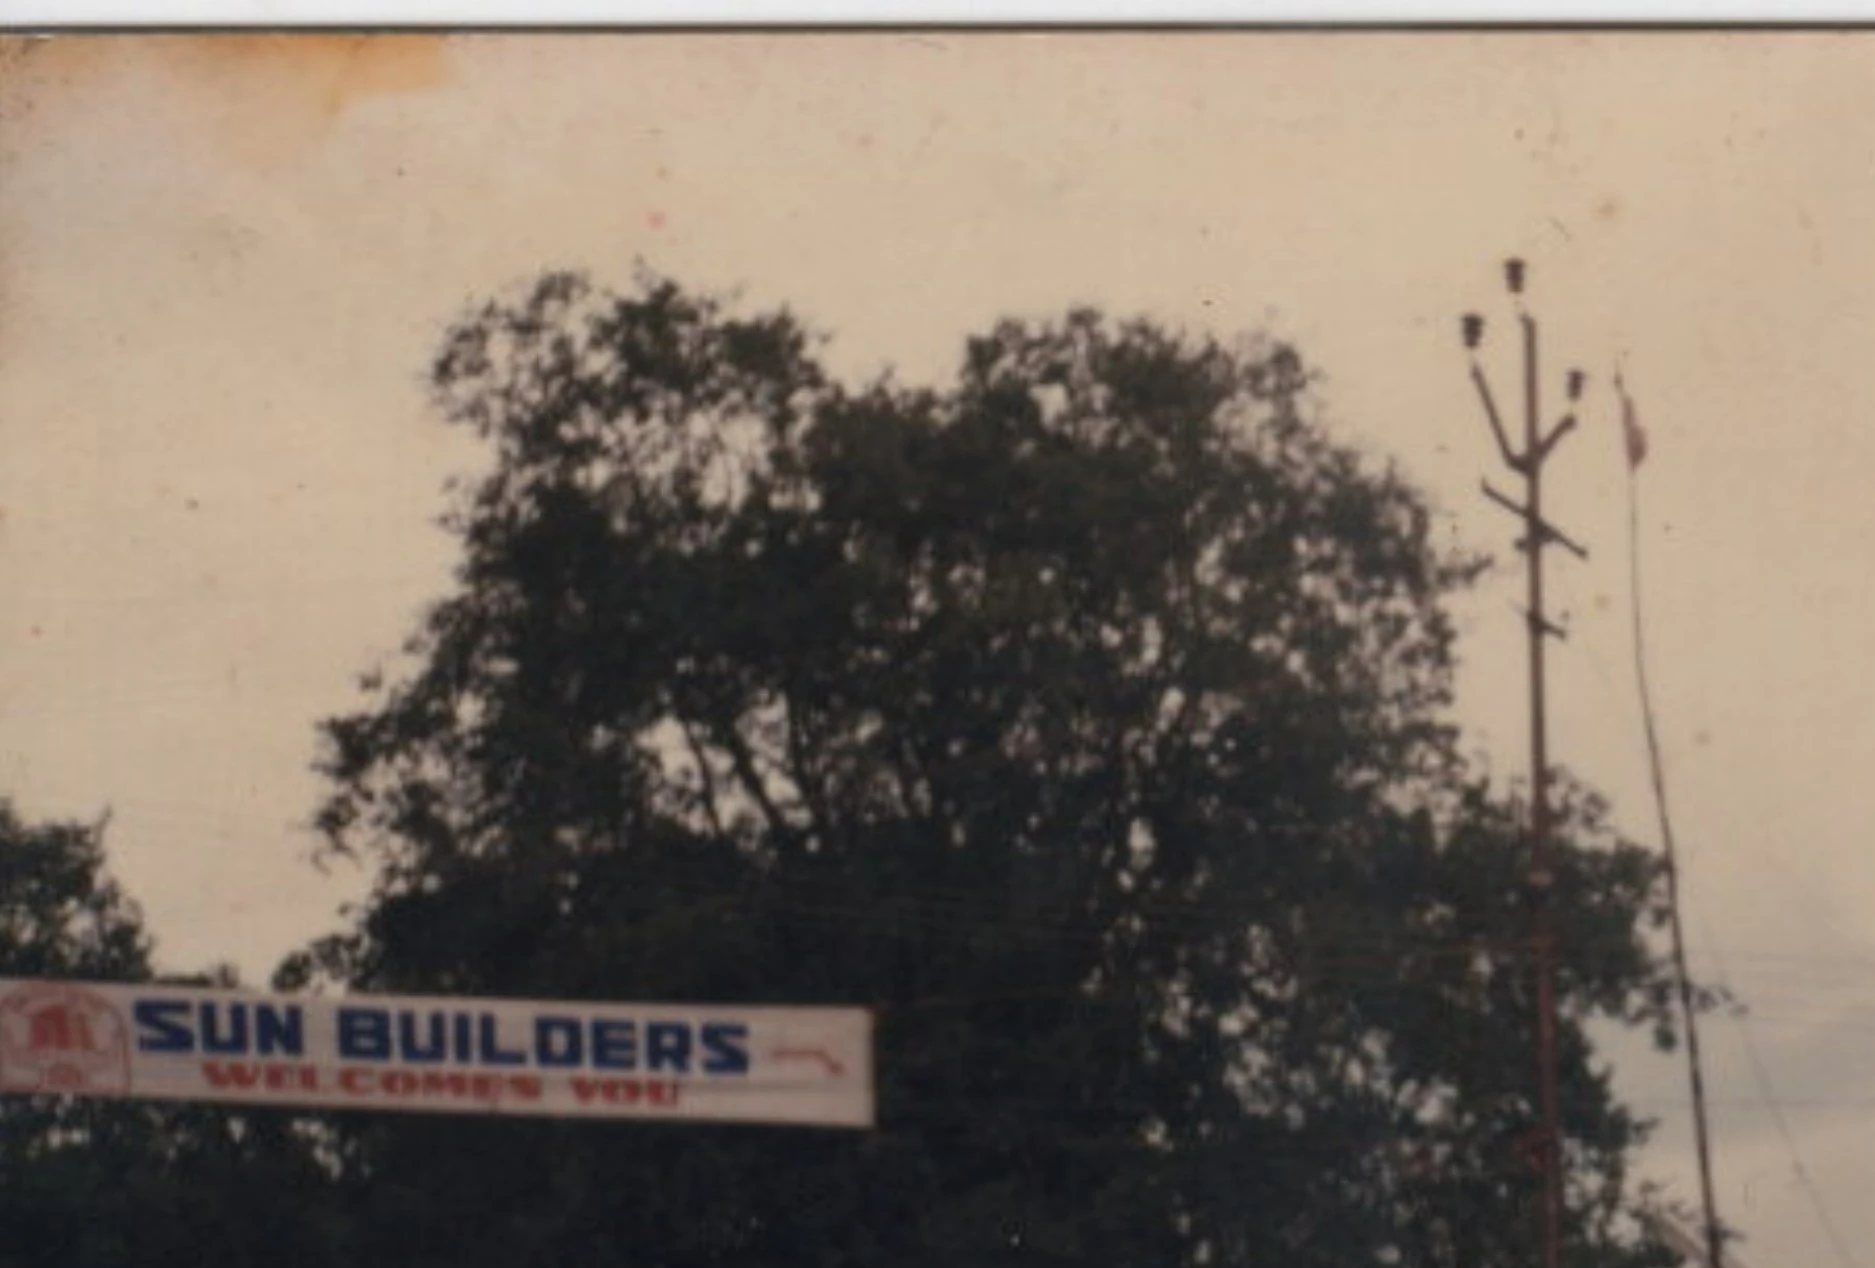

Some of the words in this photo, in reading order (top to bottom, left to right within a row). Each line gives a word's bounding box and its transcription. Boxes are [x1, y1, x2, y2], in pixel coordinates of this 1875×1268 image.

[132, 999, 306, 1057] SUN
[336, 1007, 750, 1075] BUILDERS
[200, 1061, 543, 1103] WELCOMES
[570, 1077, 681, 1107] YOU
